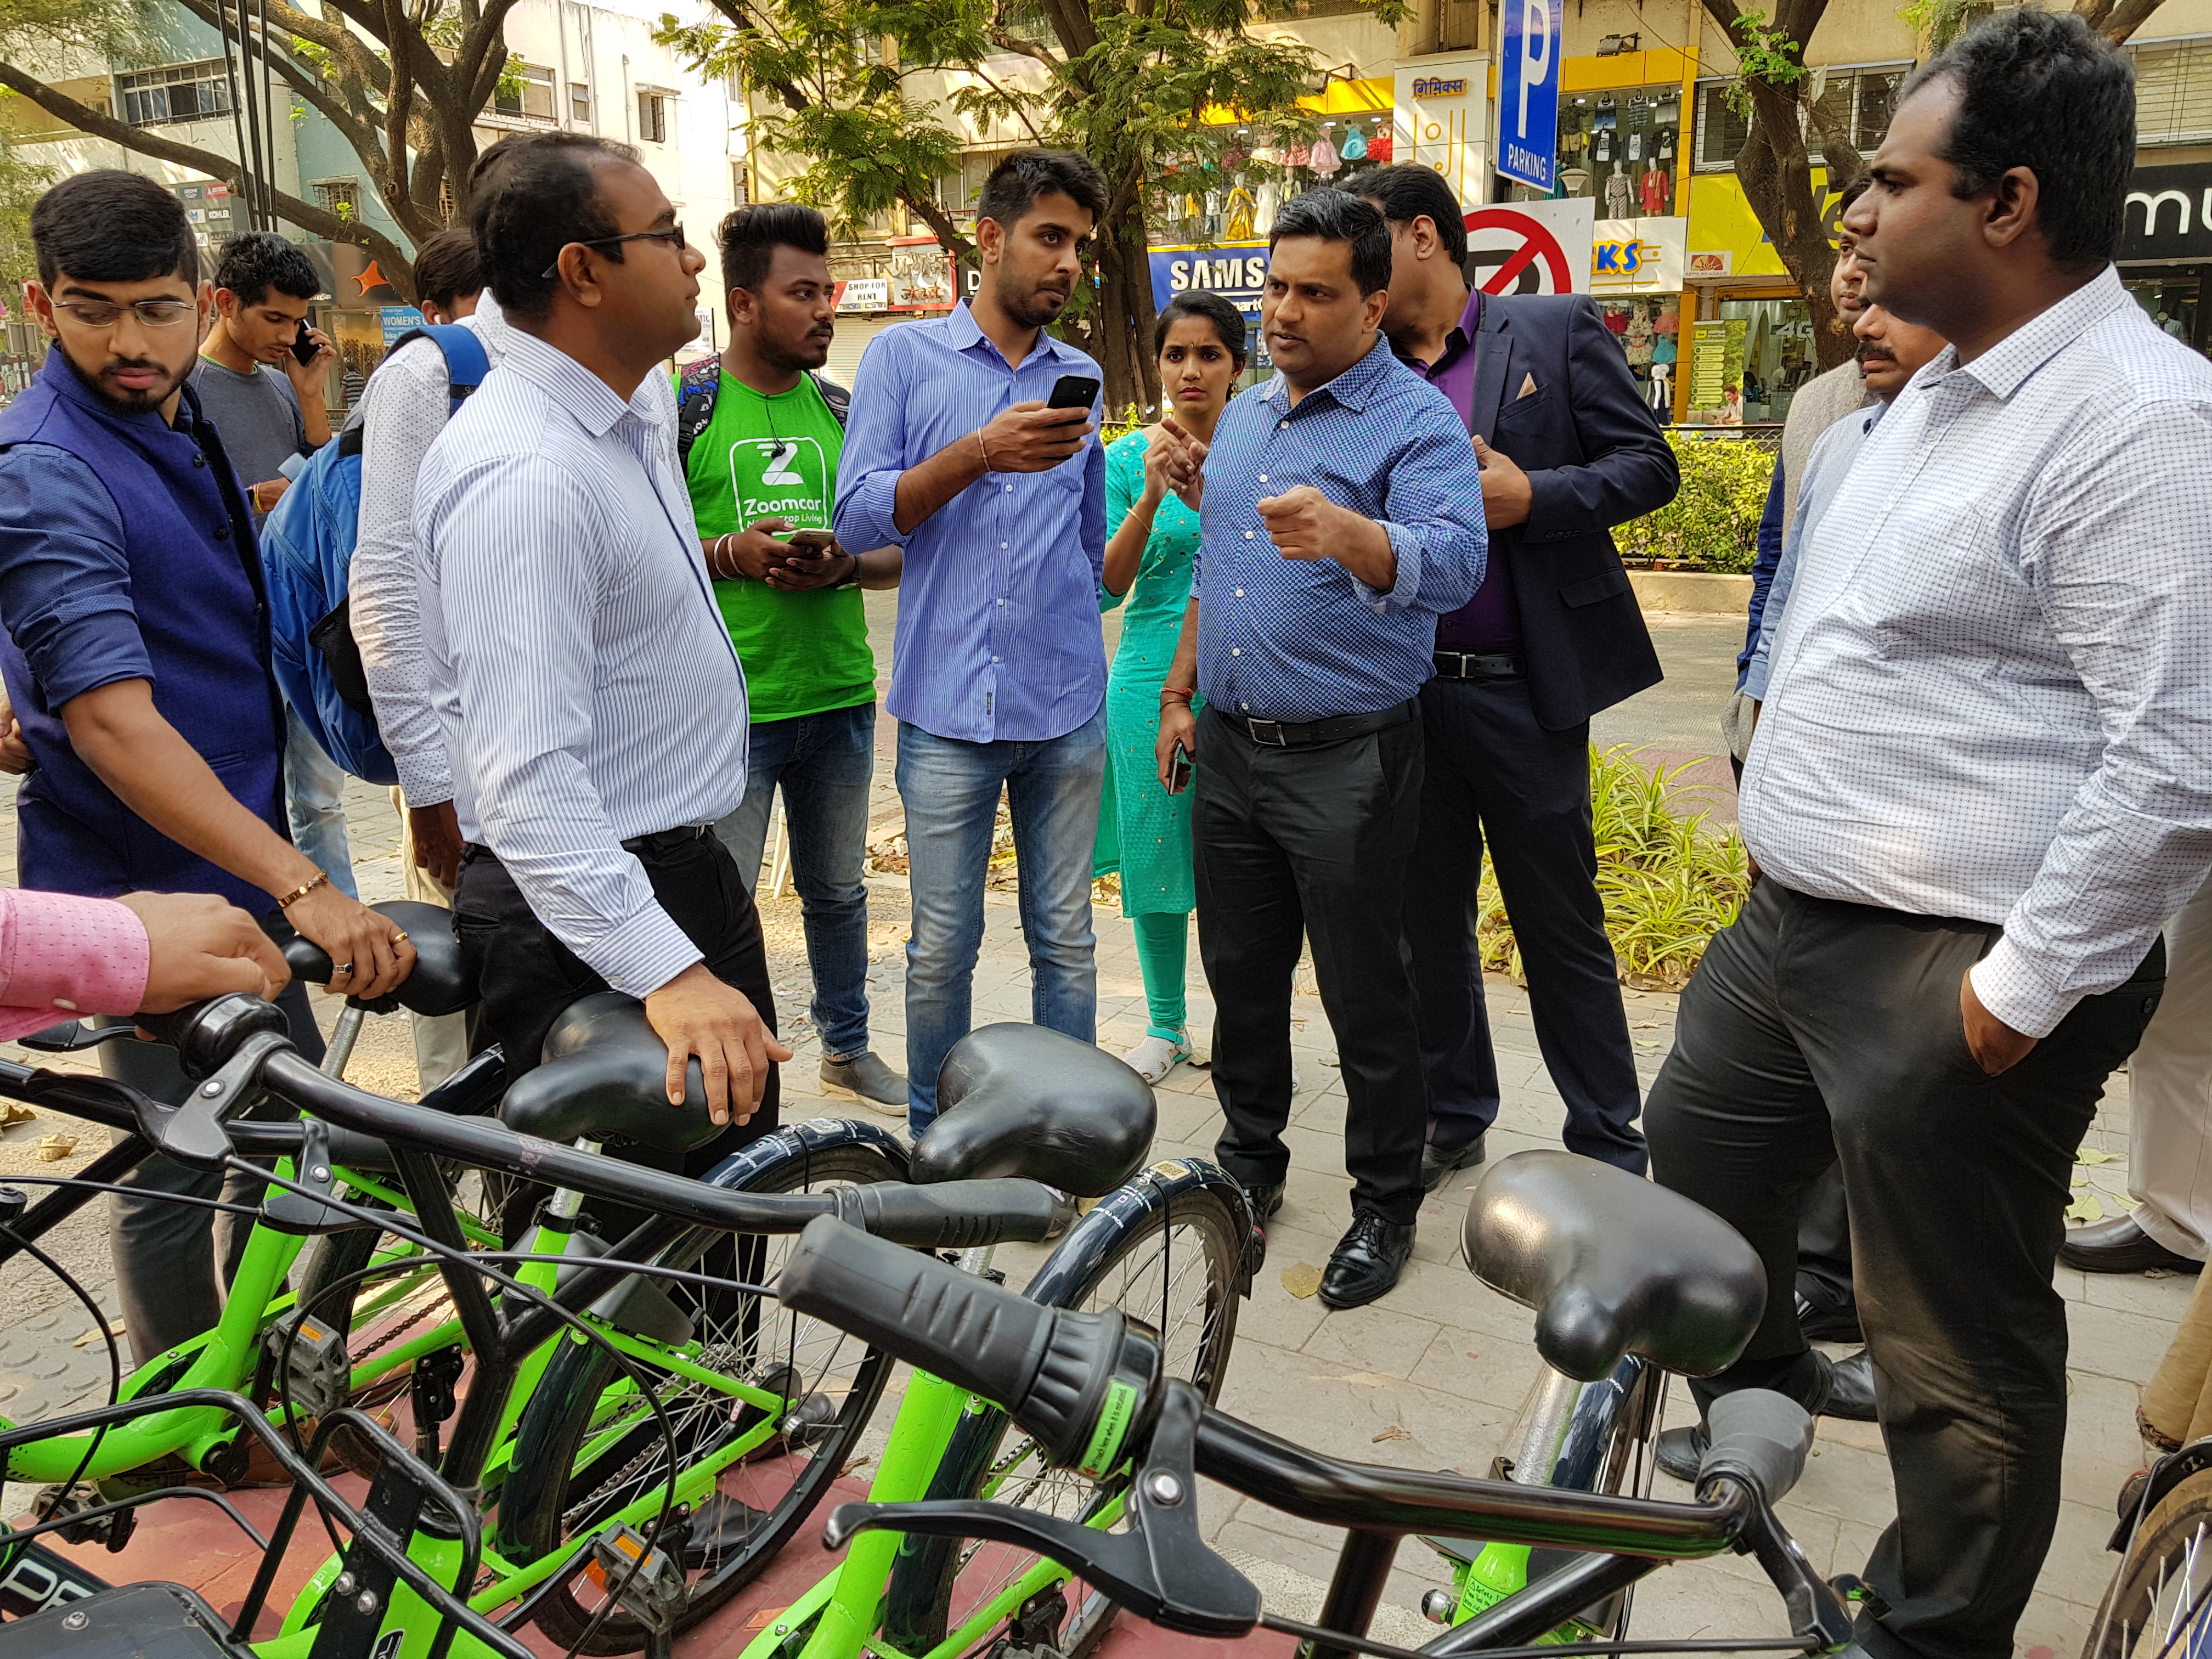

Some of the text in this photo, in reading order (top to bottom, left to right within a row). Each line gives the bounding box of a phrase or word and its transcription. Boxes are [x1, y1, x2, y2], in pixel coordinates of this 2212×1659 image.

[1517, 0, 1551, 139] P
[1413, 77, 1463, 96] गिमिक्स
[1508, 143, 1546, 181] PARKING
[1592, 242, 1638, 271] KS
[1170, 257, 1266, 290] SAMS
[383, 315, 421, 326] WOMEN'S
[1775, 320, 1814, 338] 4G
[743, 498, 821, 516] Zoomcar
[801, 514, 822, 524] Living
